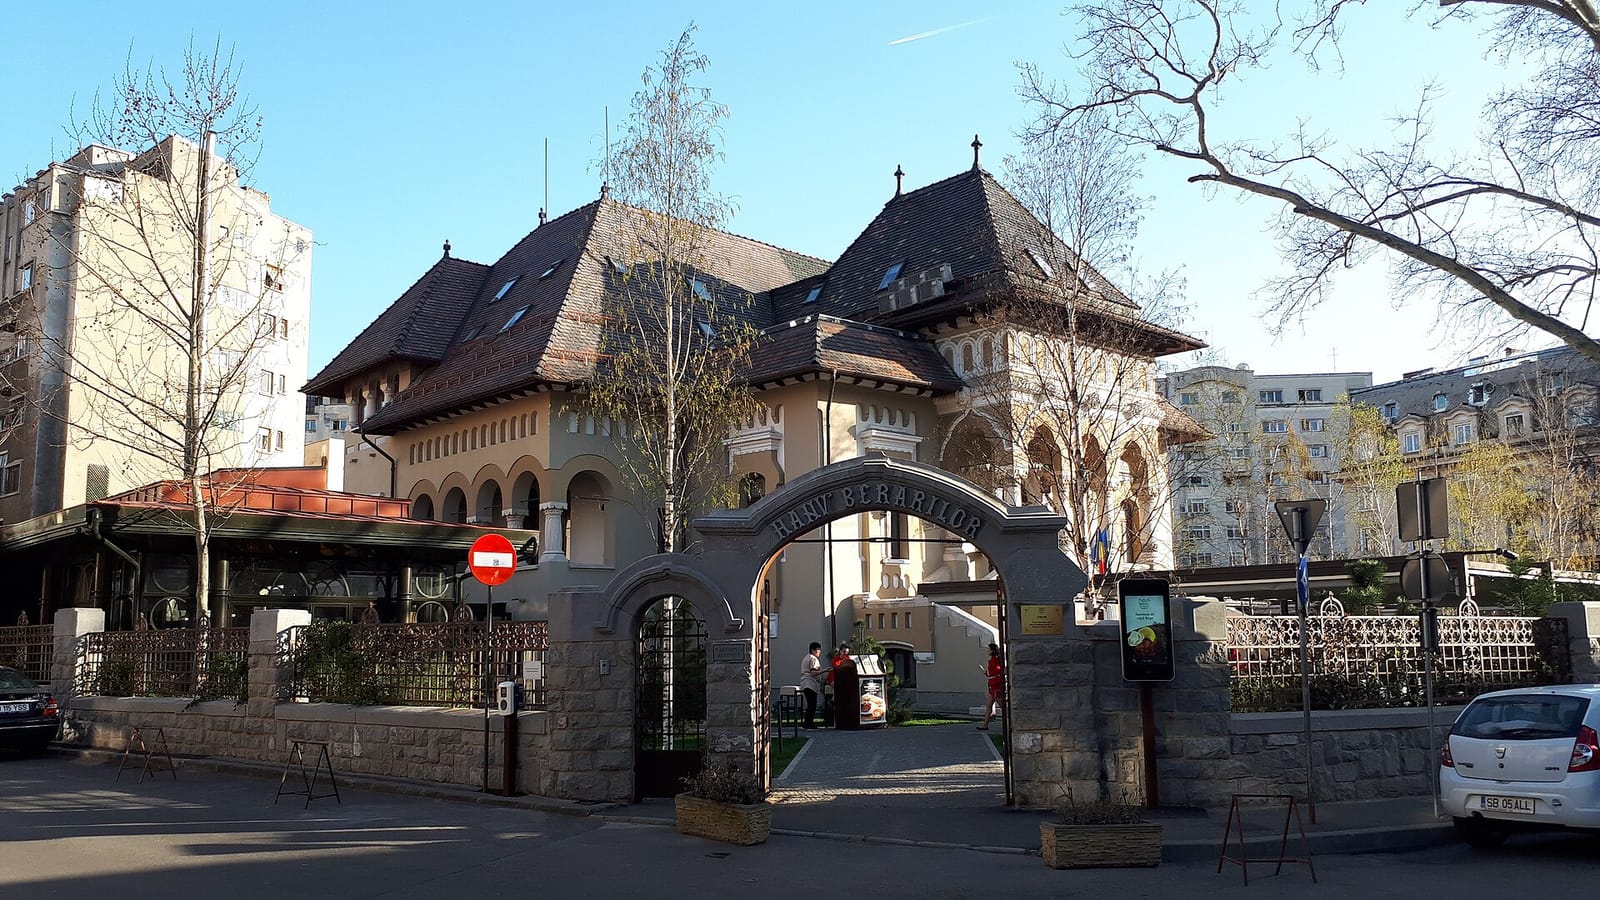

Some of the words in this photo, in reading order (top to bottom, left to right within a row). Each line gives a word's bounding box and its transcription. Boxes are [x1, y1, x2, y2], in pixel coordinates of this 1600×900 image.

[840, 483, 984, 539] BERARILOR
[1486, 797, 1499, 808] SB
[1502, 798, 1513, 809] 05
[1514, 799, 1531, 810] ALL
